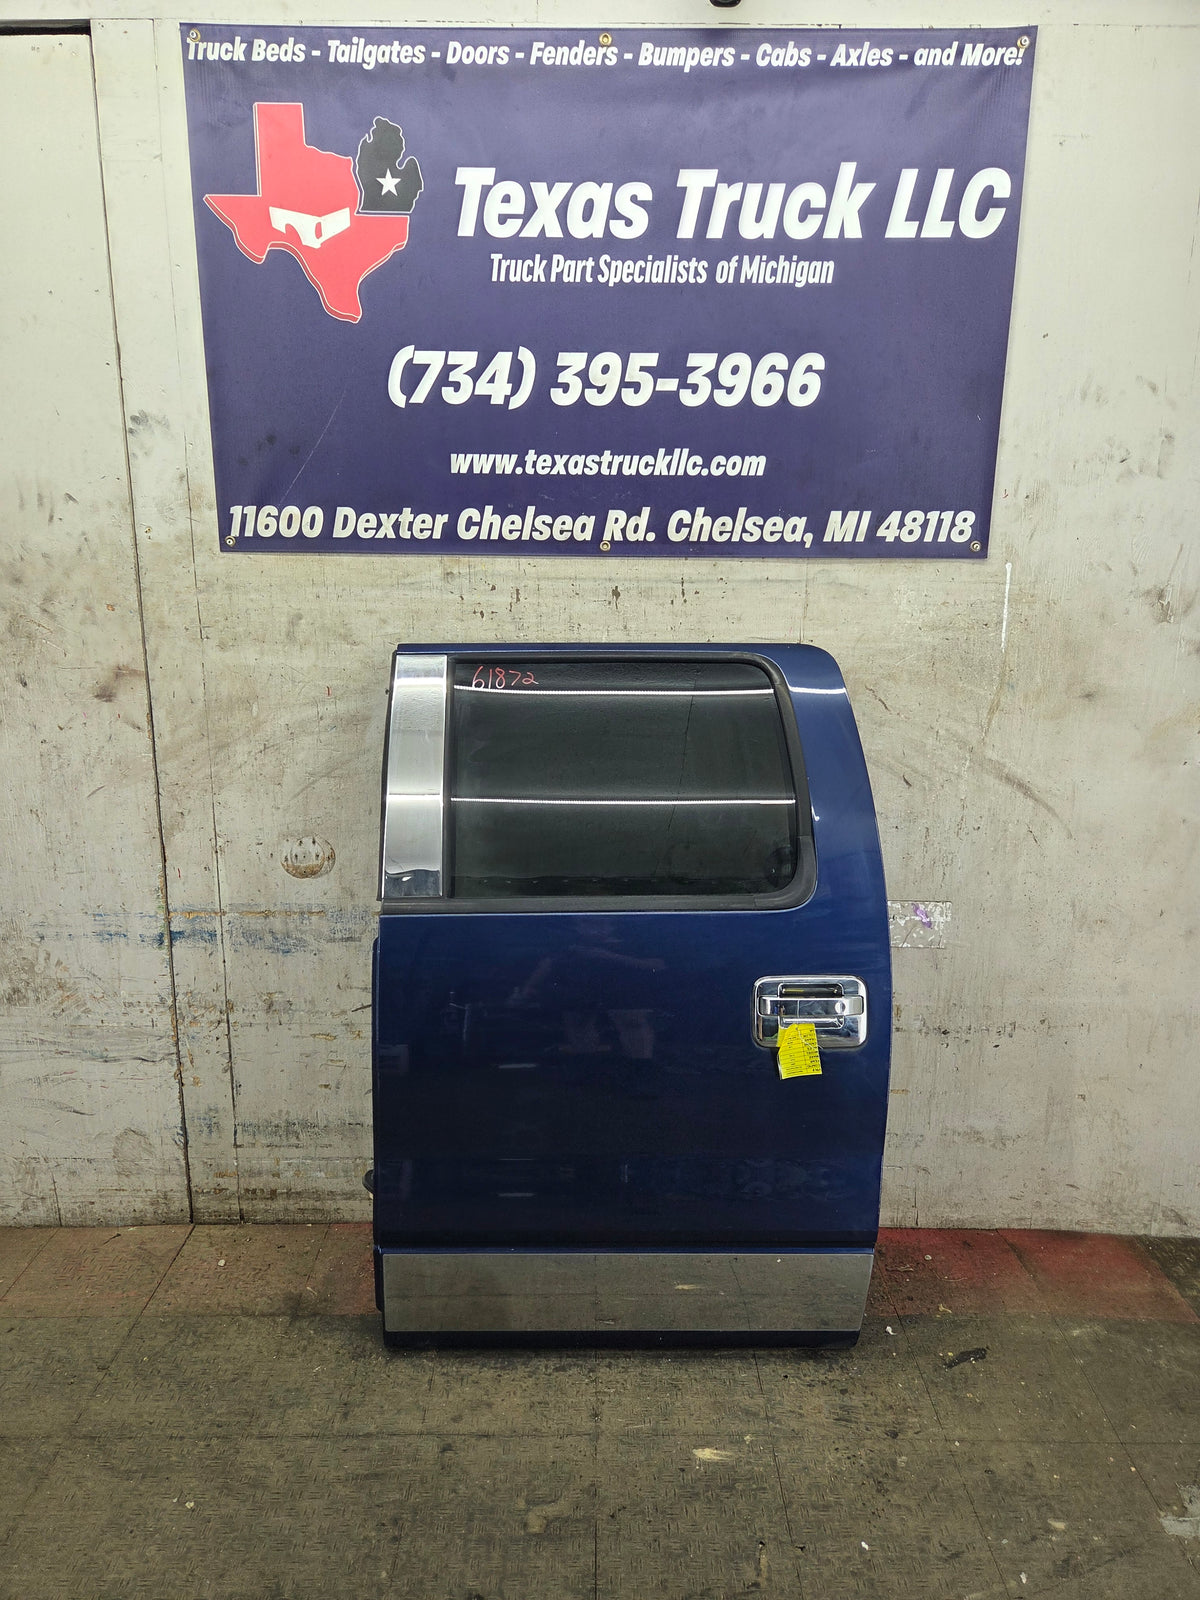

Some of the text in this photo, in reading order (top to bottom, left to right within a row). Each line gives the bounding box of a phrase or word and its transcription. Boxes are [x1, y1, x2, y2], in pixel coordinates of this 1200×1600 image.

[187, 36, 246, 61] Truck
[251, 39, 305, 62] Beds
[328, 39, 425, 69] Tailgates
[446, 42, 509, 65] Doors
[530, 42, 618, 66] Fenders
[638, 43, 735, 72] Bumpers
[756, 43, 811, 66] Cabs
[830, 43, 893, 66] Axles
[914, 42, 955, 66] and
[961, 42, 1025, 66] More!
[455, 161, 1011, 239] Texas Truck LLC
[490, 253, 835, 287] Truck Part Specialists of Michigan
[387, 344, 825, 410] (734) 395-3966
[450, 448, 767, 476] www.texastruckllc.com
[229, 505, 975, 548] 11600 Dexter Chelsea Rd. Chelsea, MI 48118
[472, 665, 539, 689] 61872
